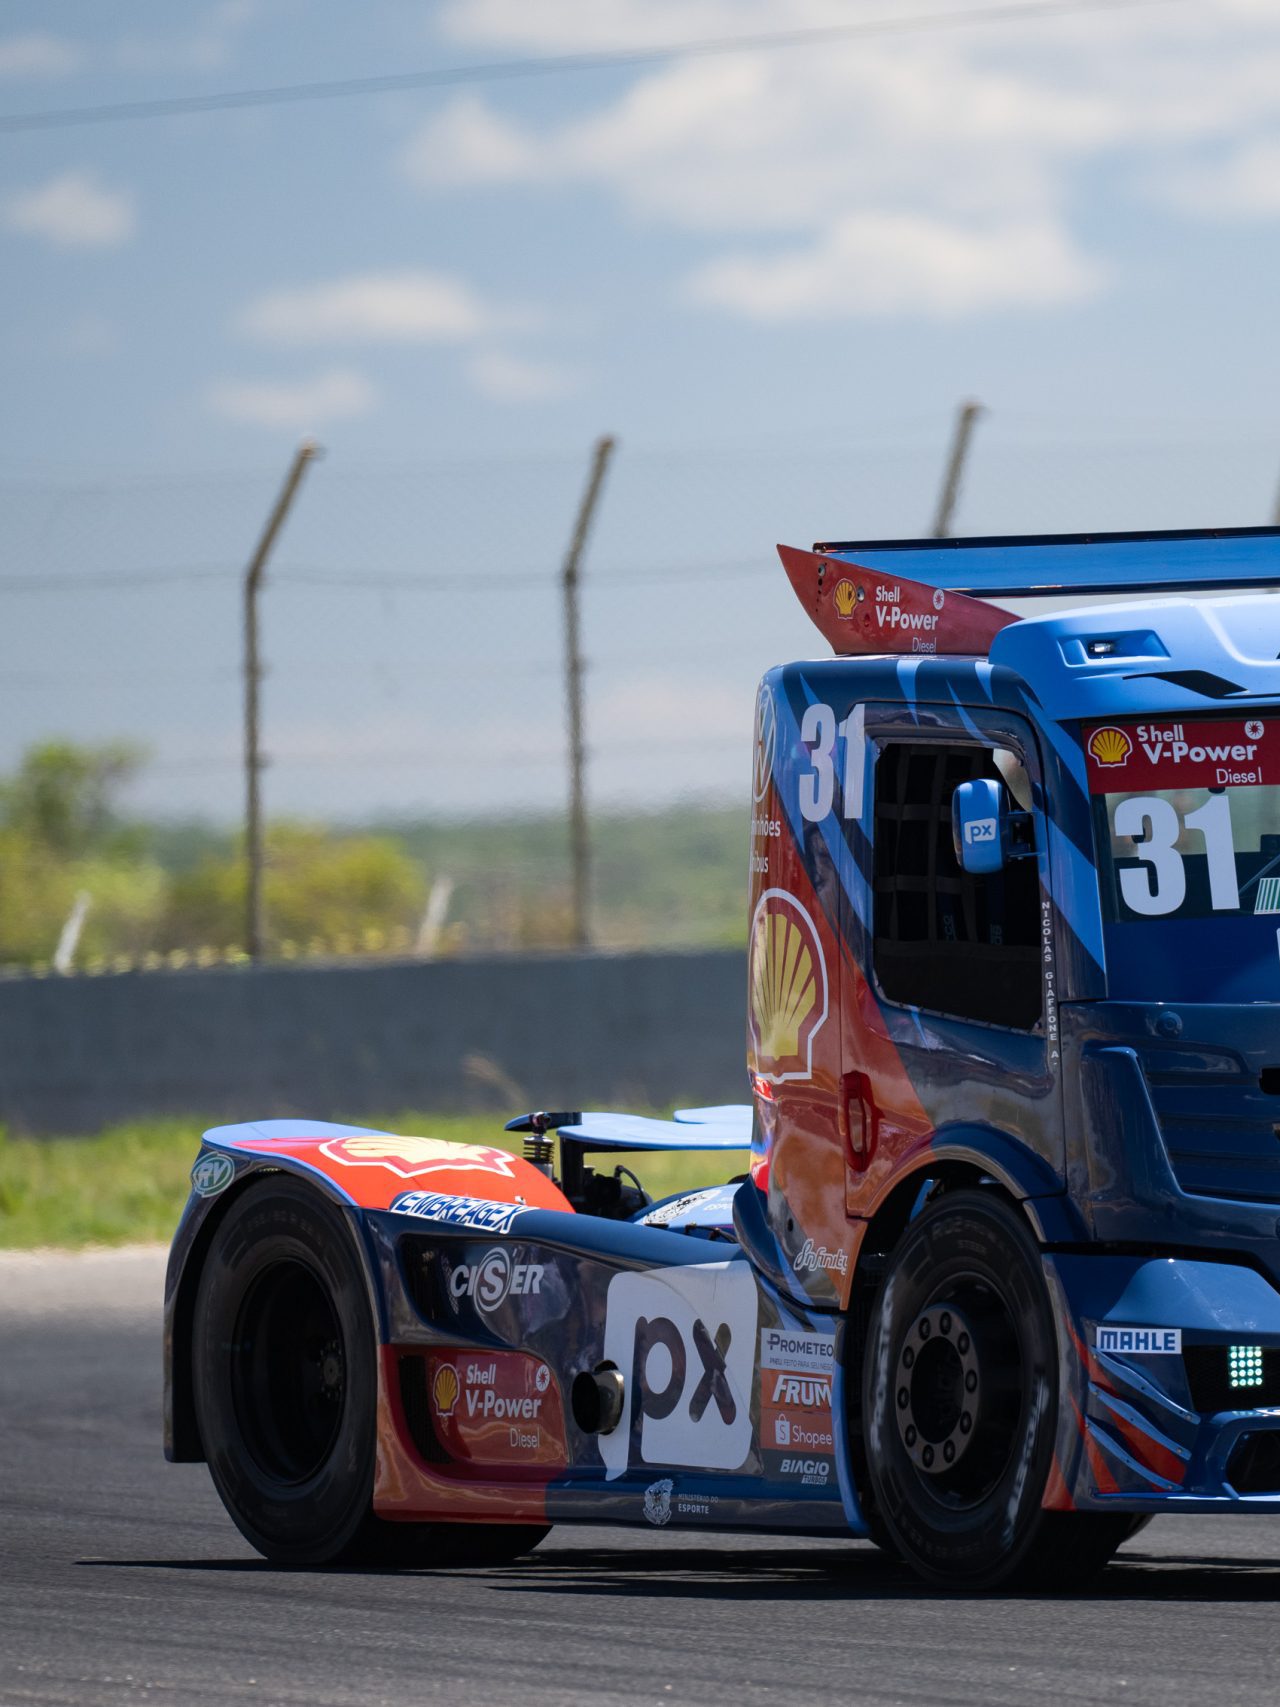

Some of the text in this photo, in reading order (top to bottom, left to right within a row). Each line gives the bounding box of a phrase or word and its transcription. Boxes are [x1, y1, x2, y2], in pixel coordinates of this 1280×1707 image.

[876, 585, 900, 603] Shell
[875, 605, 939, 631] V-Power
[912, 636, 937, 654] Diesel
[1136, 724, 1185, 742] Shell
[798, 703, 866, 822] 31
[1142, 742, 1258, 765] V-Power
[1216, 766, 1263, 784] Diesel
[970, 824, 992, 846] px
[1114, 794, 1240, 916] 31
[1041, 902, 1052, 962] NICOLAS
[450, 1255, 545, 1304] CISER
[767, 1333, 834, 1357] PROMETEO
[1100, 1331, 1176, 1351] MAHLE
[466, 1363, 497, 1385] Shell
[629, 1315, 737, 1464] px
[772, 1375, 832, 1408] FRUM
[465, 1389, 542, 1418] V-Power
[510, 1427, 540, 1448] Diesel
[792, 1425, 833, 1449] Shopee
[780, 1459, 830, 1477] BIAGIO
[678, 1503, 710, 1515] ESPORTE
